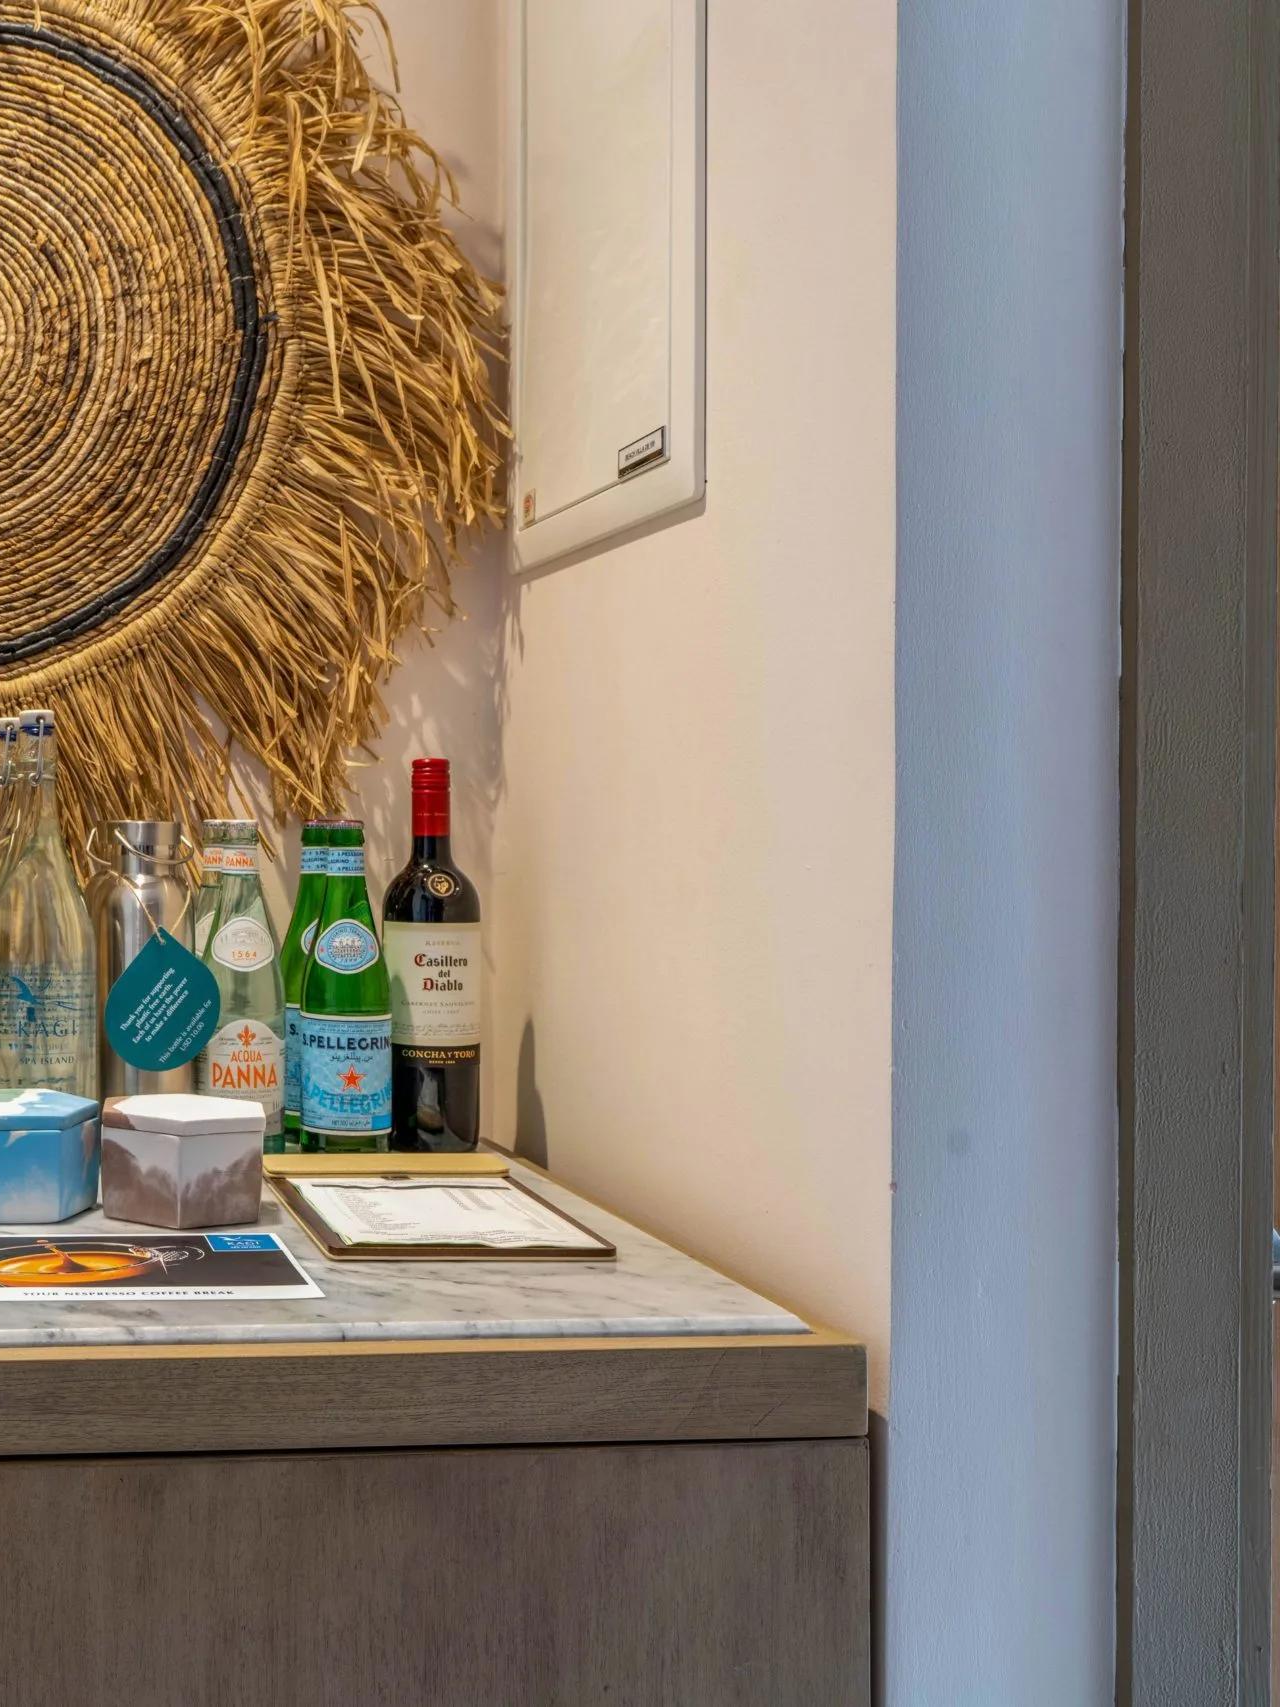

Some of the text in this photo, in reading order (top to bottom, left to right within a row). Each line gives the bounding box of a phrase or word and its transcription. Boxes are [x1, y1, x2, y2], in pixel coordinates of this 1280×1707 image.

[226, 855, 256, 867] PANNA
[414, 953, 468, 967] Casillero
[438, 970, 451, 978] del
[422, 978, 463, 991] Diablo
[120, 1014, 136, 1030] Thank
[150, 968, 175, 996] supporting
[132, 1030, 145, 1043] Each
[153, 1004, 166, 1017] have
[173, 978, 187, 996] power
[135, 1010, 151, 1028] plastic
[148, 999, 160, 1010] free
[151, 1020, 164, 1036] make
[166, 990, 188, 1016] difference
[186, 1008, 205, 1031] available
[302, 1033, 392, 1050] S.PELLEGRIN
[39, 1054, 75, 1064] ISLAND
[231, 1050, 263, 1062] ACQUA
[402, 1049, 446, 1059] CONCHA
[454, 1049, 476, 1059] TORO
[211, 1062, 278, 1089] PANNA
